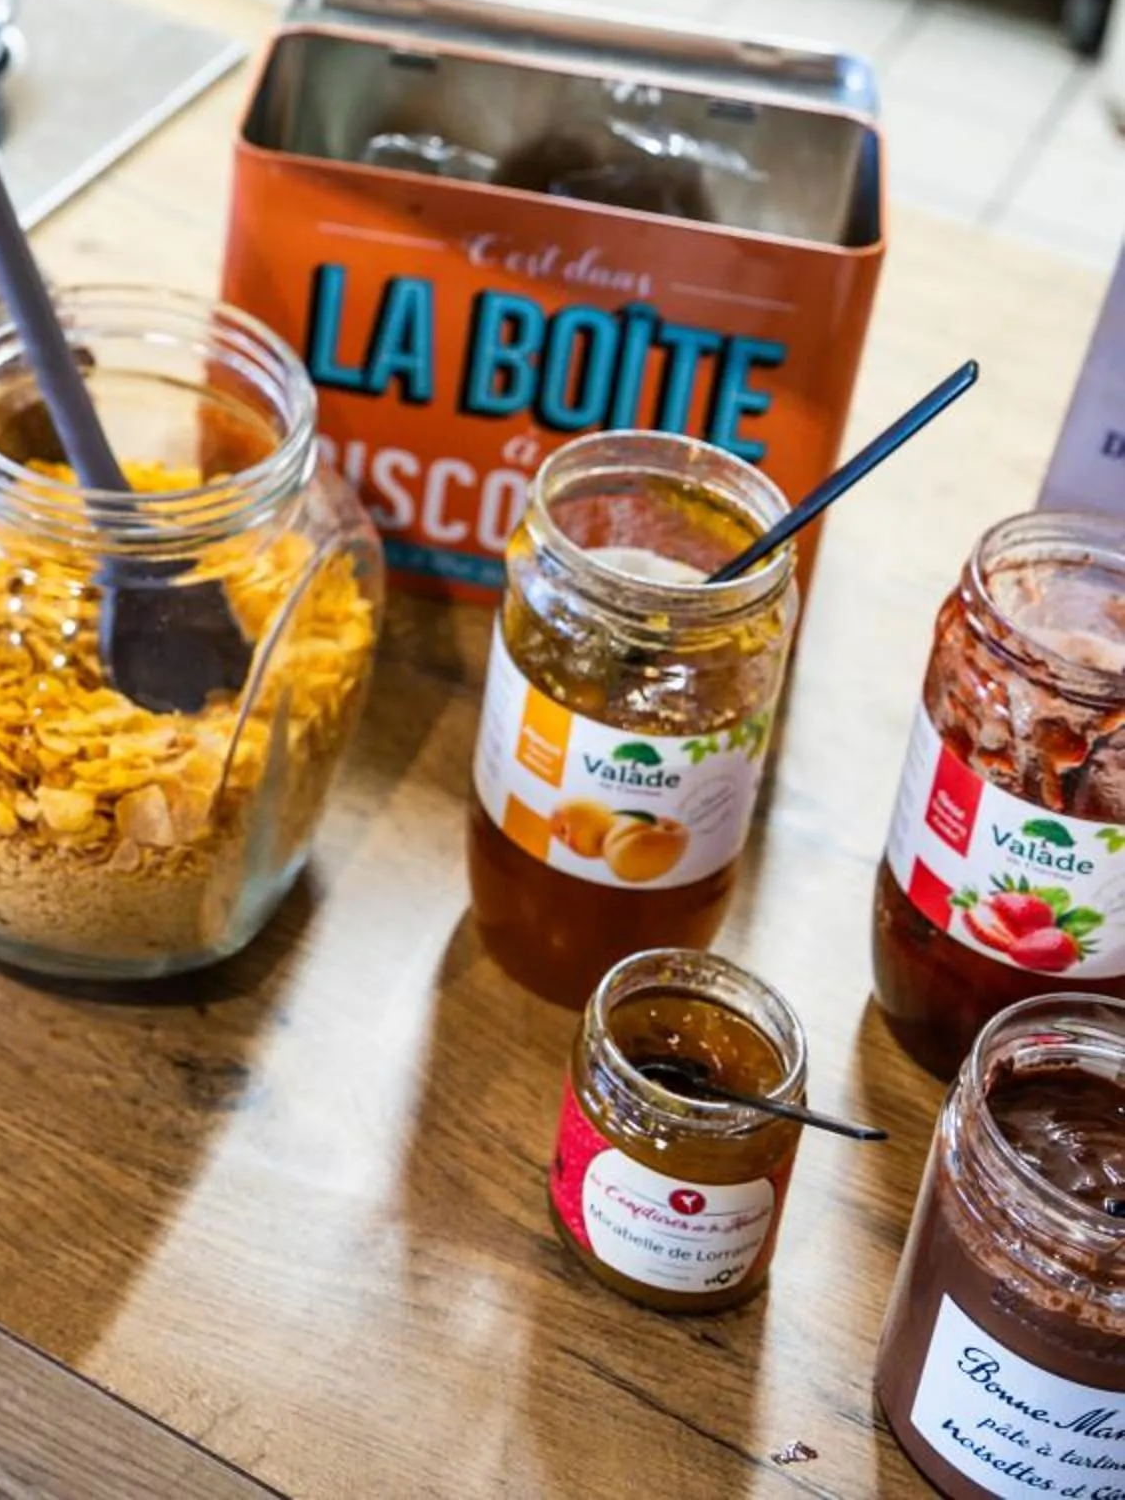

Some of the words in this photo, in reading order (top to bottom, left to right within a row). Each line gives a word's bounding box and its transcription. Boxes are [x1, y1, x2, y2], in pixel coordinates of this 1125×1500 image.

[306, 263, 434, 404] LA
[583, 753, 682, 789] Valade
[992, 822, 1095, 875] Valade
[668, 1248, 692, 1261] de
[957, 1346, 1050, 1424] Bonne
[941, 1418, 1054, 1491] noisettes
[1060, 1483, 1088, 1498] et
[977, 1417, 1030, 1447] pâte
[1035, 1441, 1053, 1457] à
[1059, 1449, 1125, 1470] tartin
